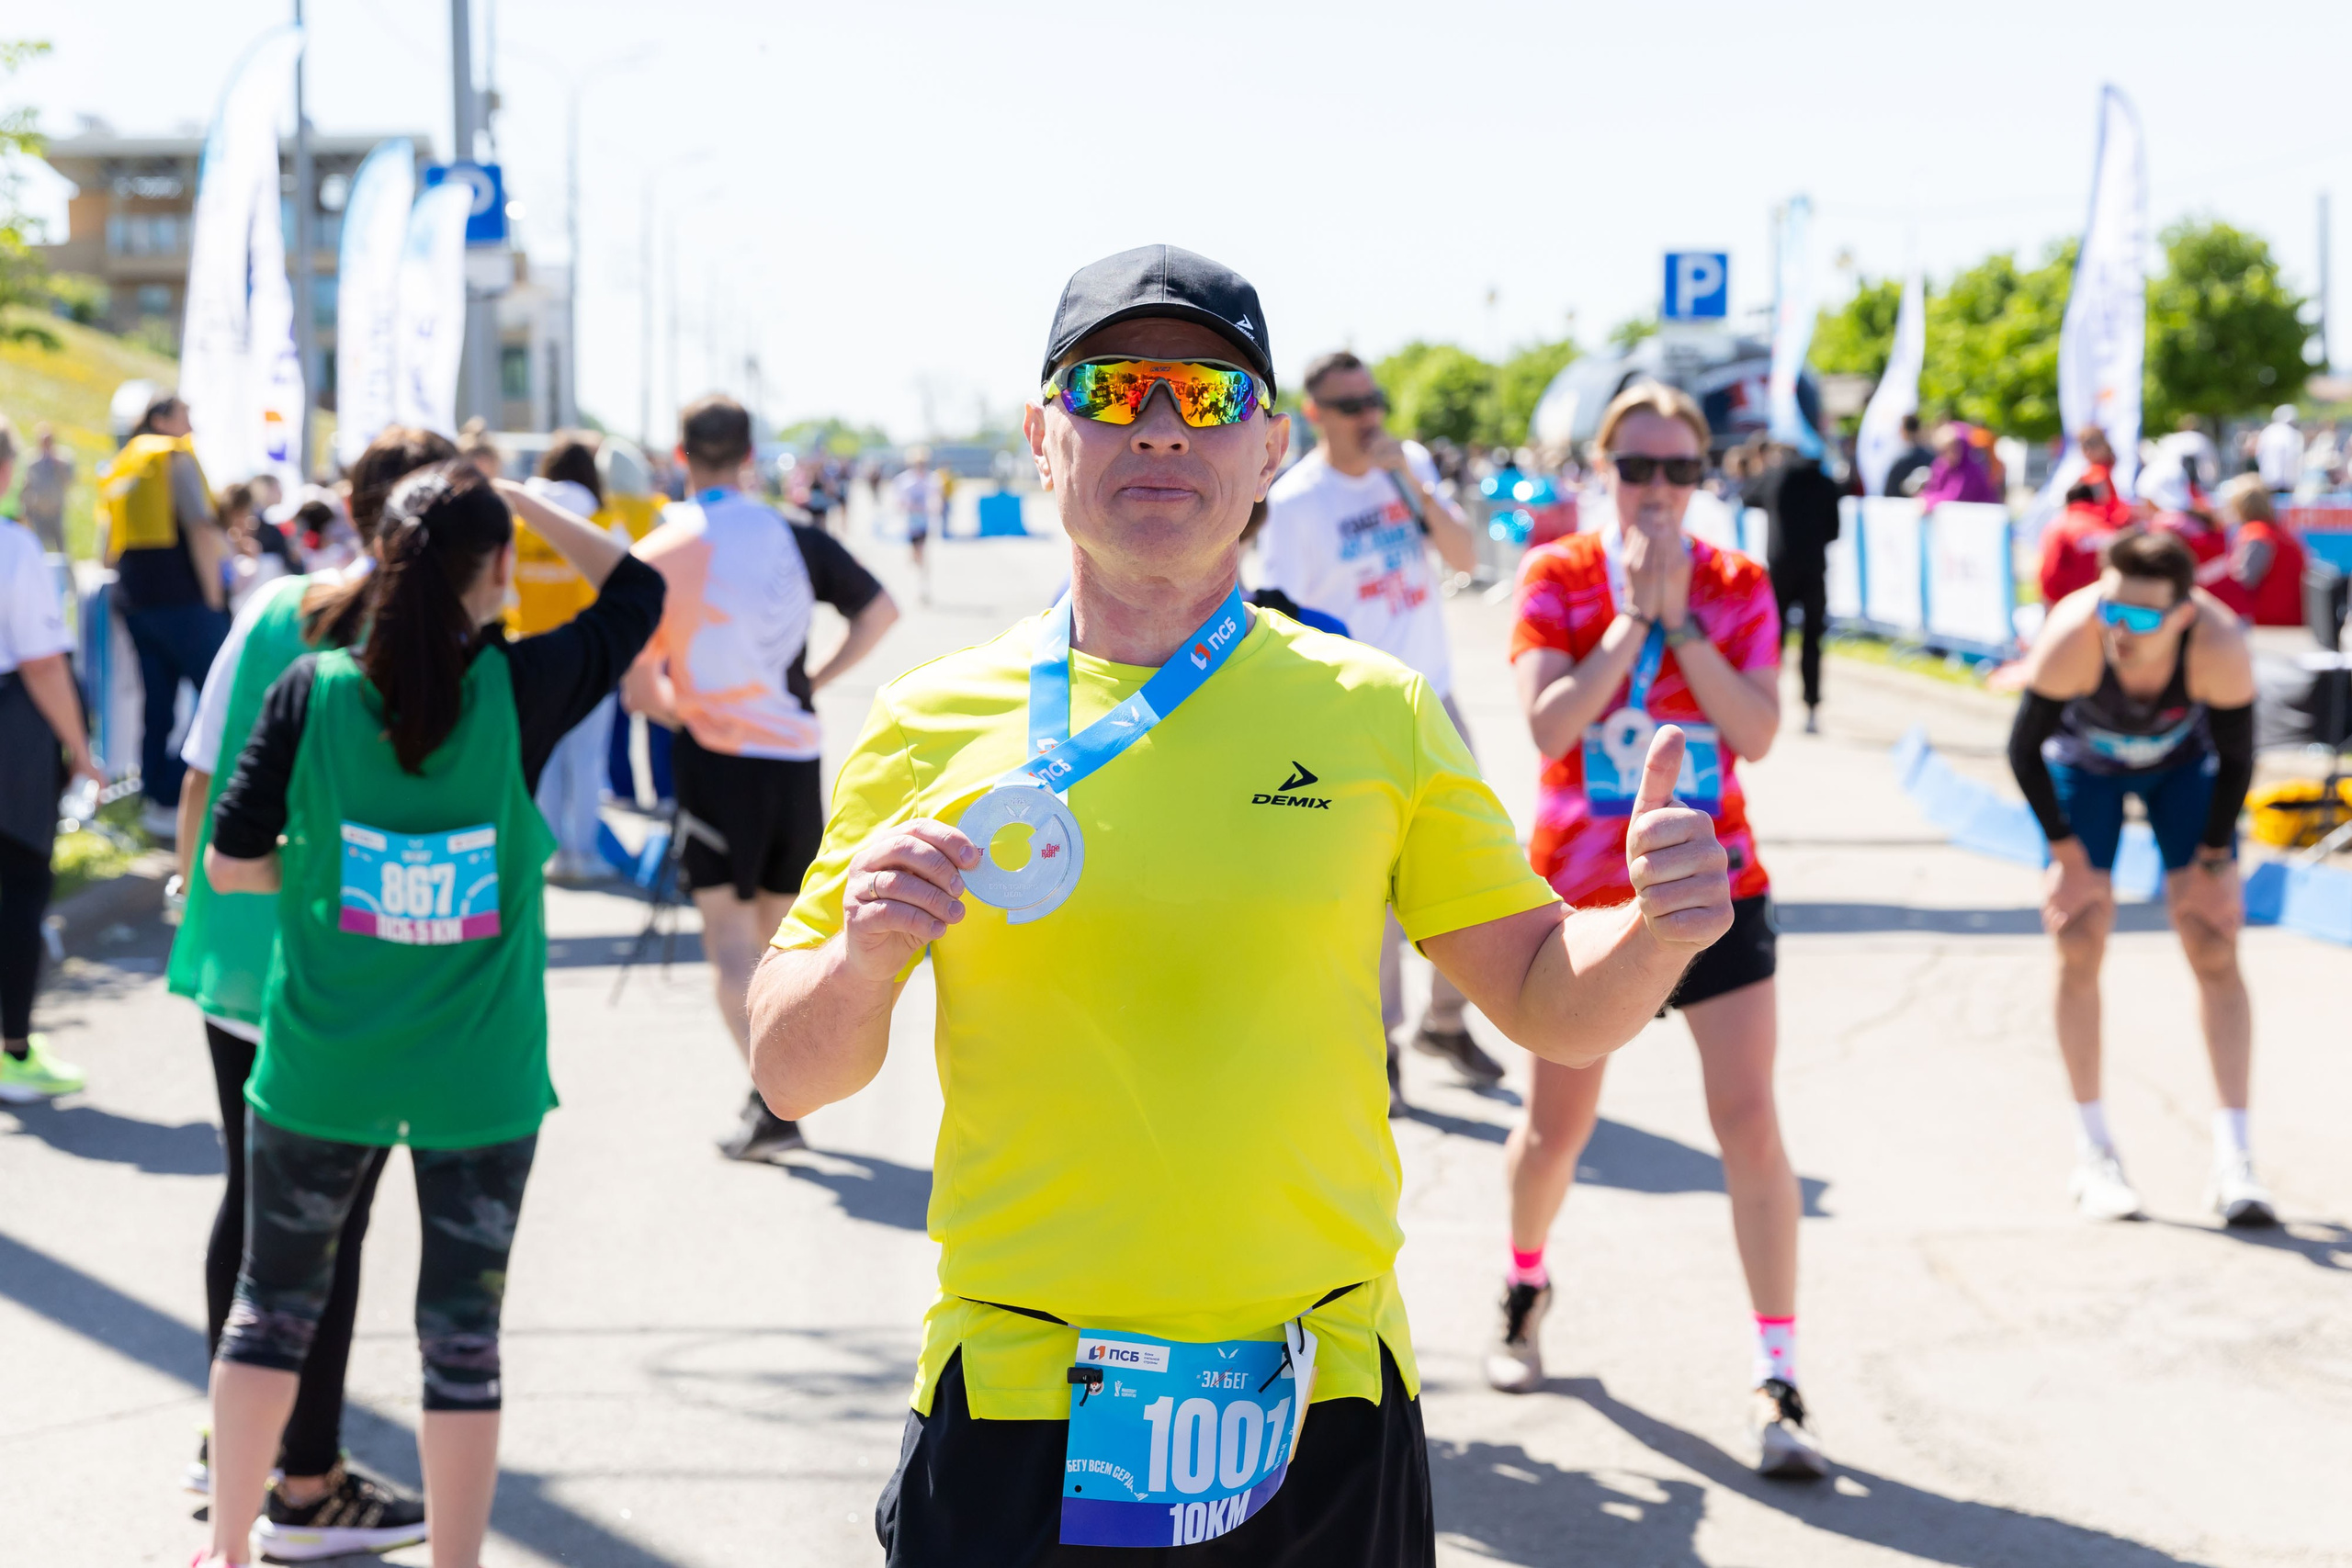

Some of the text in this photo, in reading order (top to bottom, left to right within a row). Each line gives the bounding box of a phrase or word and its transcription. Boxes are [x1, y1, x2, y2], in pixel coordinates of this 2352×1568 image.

[1676, 253, 1724, 316] P
[1207, 615, 1237, 651] ПСБ
[1036, 758, 1073, 783] ПСБ
[1251, 794, 1332, 809] DEMIX
[380, 861, 457, 918] 867
[1109, 1348, 1139, 1362] ПСБ
[1143, 1395, 1292, 1494] 1001
[1067, 1459, 1088, 1472] БЕГУ
[1089, 1459, 1113, 1475] ВСЕМ
[1170, 1488, 1252, 1546] 10КМ
